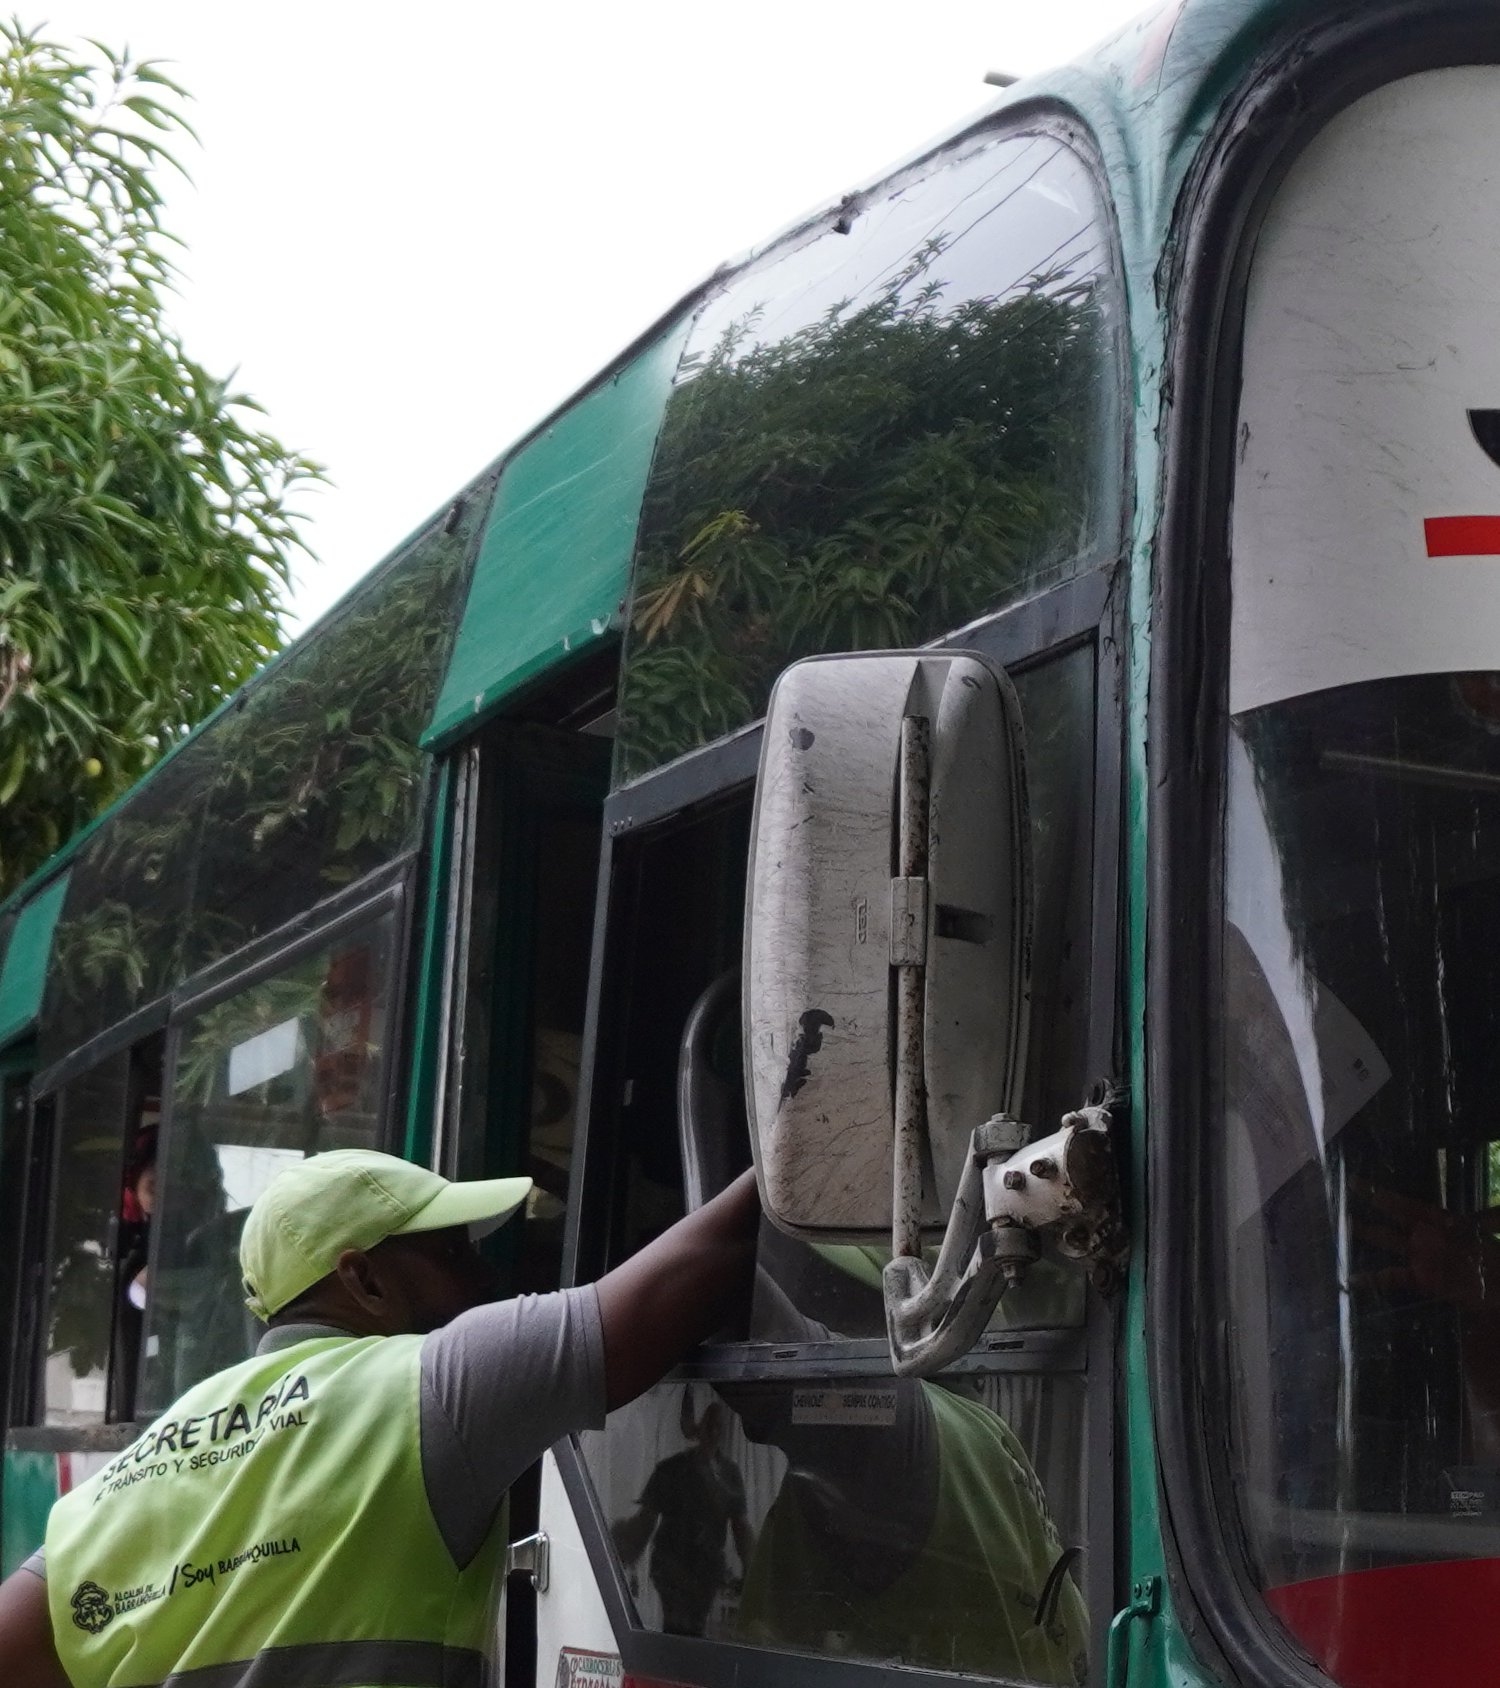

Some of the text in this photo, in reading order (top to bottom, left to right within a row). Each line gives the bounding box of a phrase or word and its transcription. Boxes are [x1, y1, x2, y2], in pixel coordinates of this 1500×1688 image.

[175, 1459, 185, 1474] Y
[190, 1428, 266, 1471] SEGURID
[270, 1411, 309, 1432] VIAL
[181, 1562, 215, 1588] Soy
